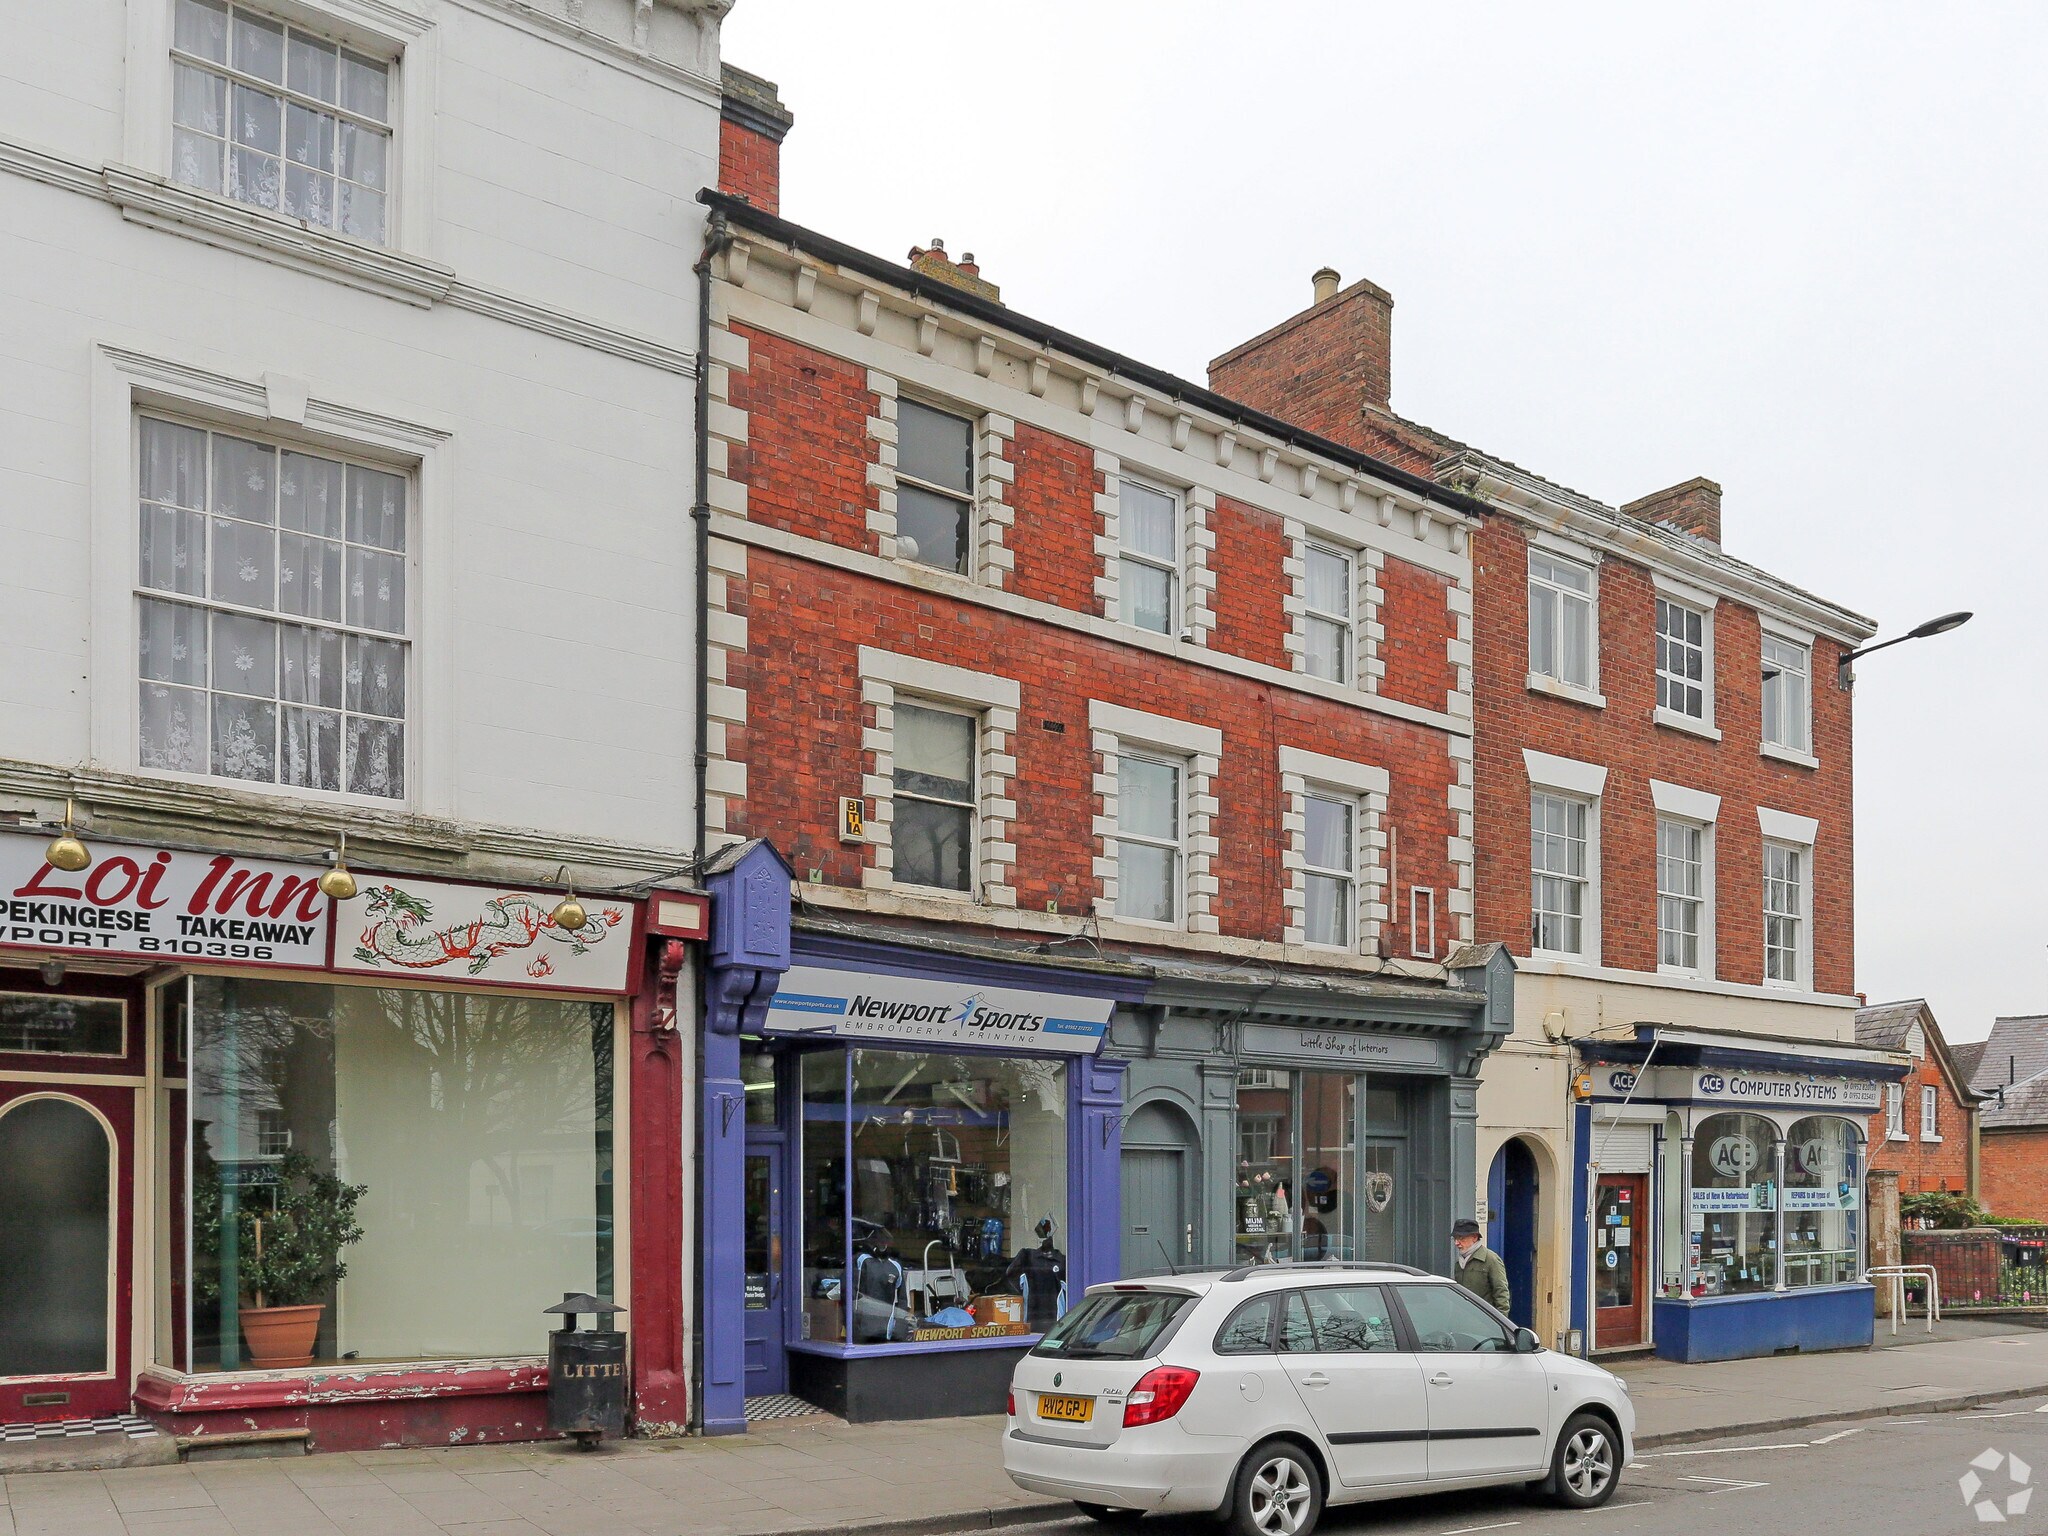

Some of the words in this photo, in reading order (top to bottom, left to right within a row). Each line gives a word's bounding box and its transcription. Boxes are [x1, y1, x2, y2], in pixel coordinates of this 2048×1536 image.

[13, 851, 172, 909] Loi
[188, 855, 322, 922] Inn
[177, 915, 315, 945] TAKEAWAY
[0, 926, 117, 948] PORT
[139, 937, 273, 960] 810396
[848, 995, 952, 1024] Newport
[968, 1007, 1043, 1031] Sports
[845, 1021, 942, 1035] EMBROIDERY
[968, 1031, 1034, 1043] PRINTING
[1301, 1033, 1322, 1049] Little
[1325, 1036, 1345, 1055] Shop
[1348, 1038, 1356, 1055] of
[1358, 1039, 1388, 1054] Interiors
[1613, 1075, 1633, 1088] ACE
[1702, 1077, 1721, 1091] ACE
[1717, 1143, 1751, 1166] ACE
[1693, 1192, 1705, 1200] SALES
[916, 1328, 965, 1341] NEWPORT
[971, 1326, 1006, 1338] SPORTS
[1065, 1400, 1088, 1417] GPJ
